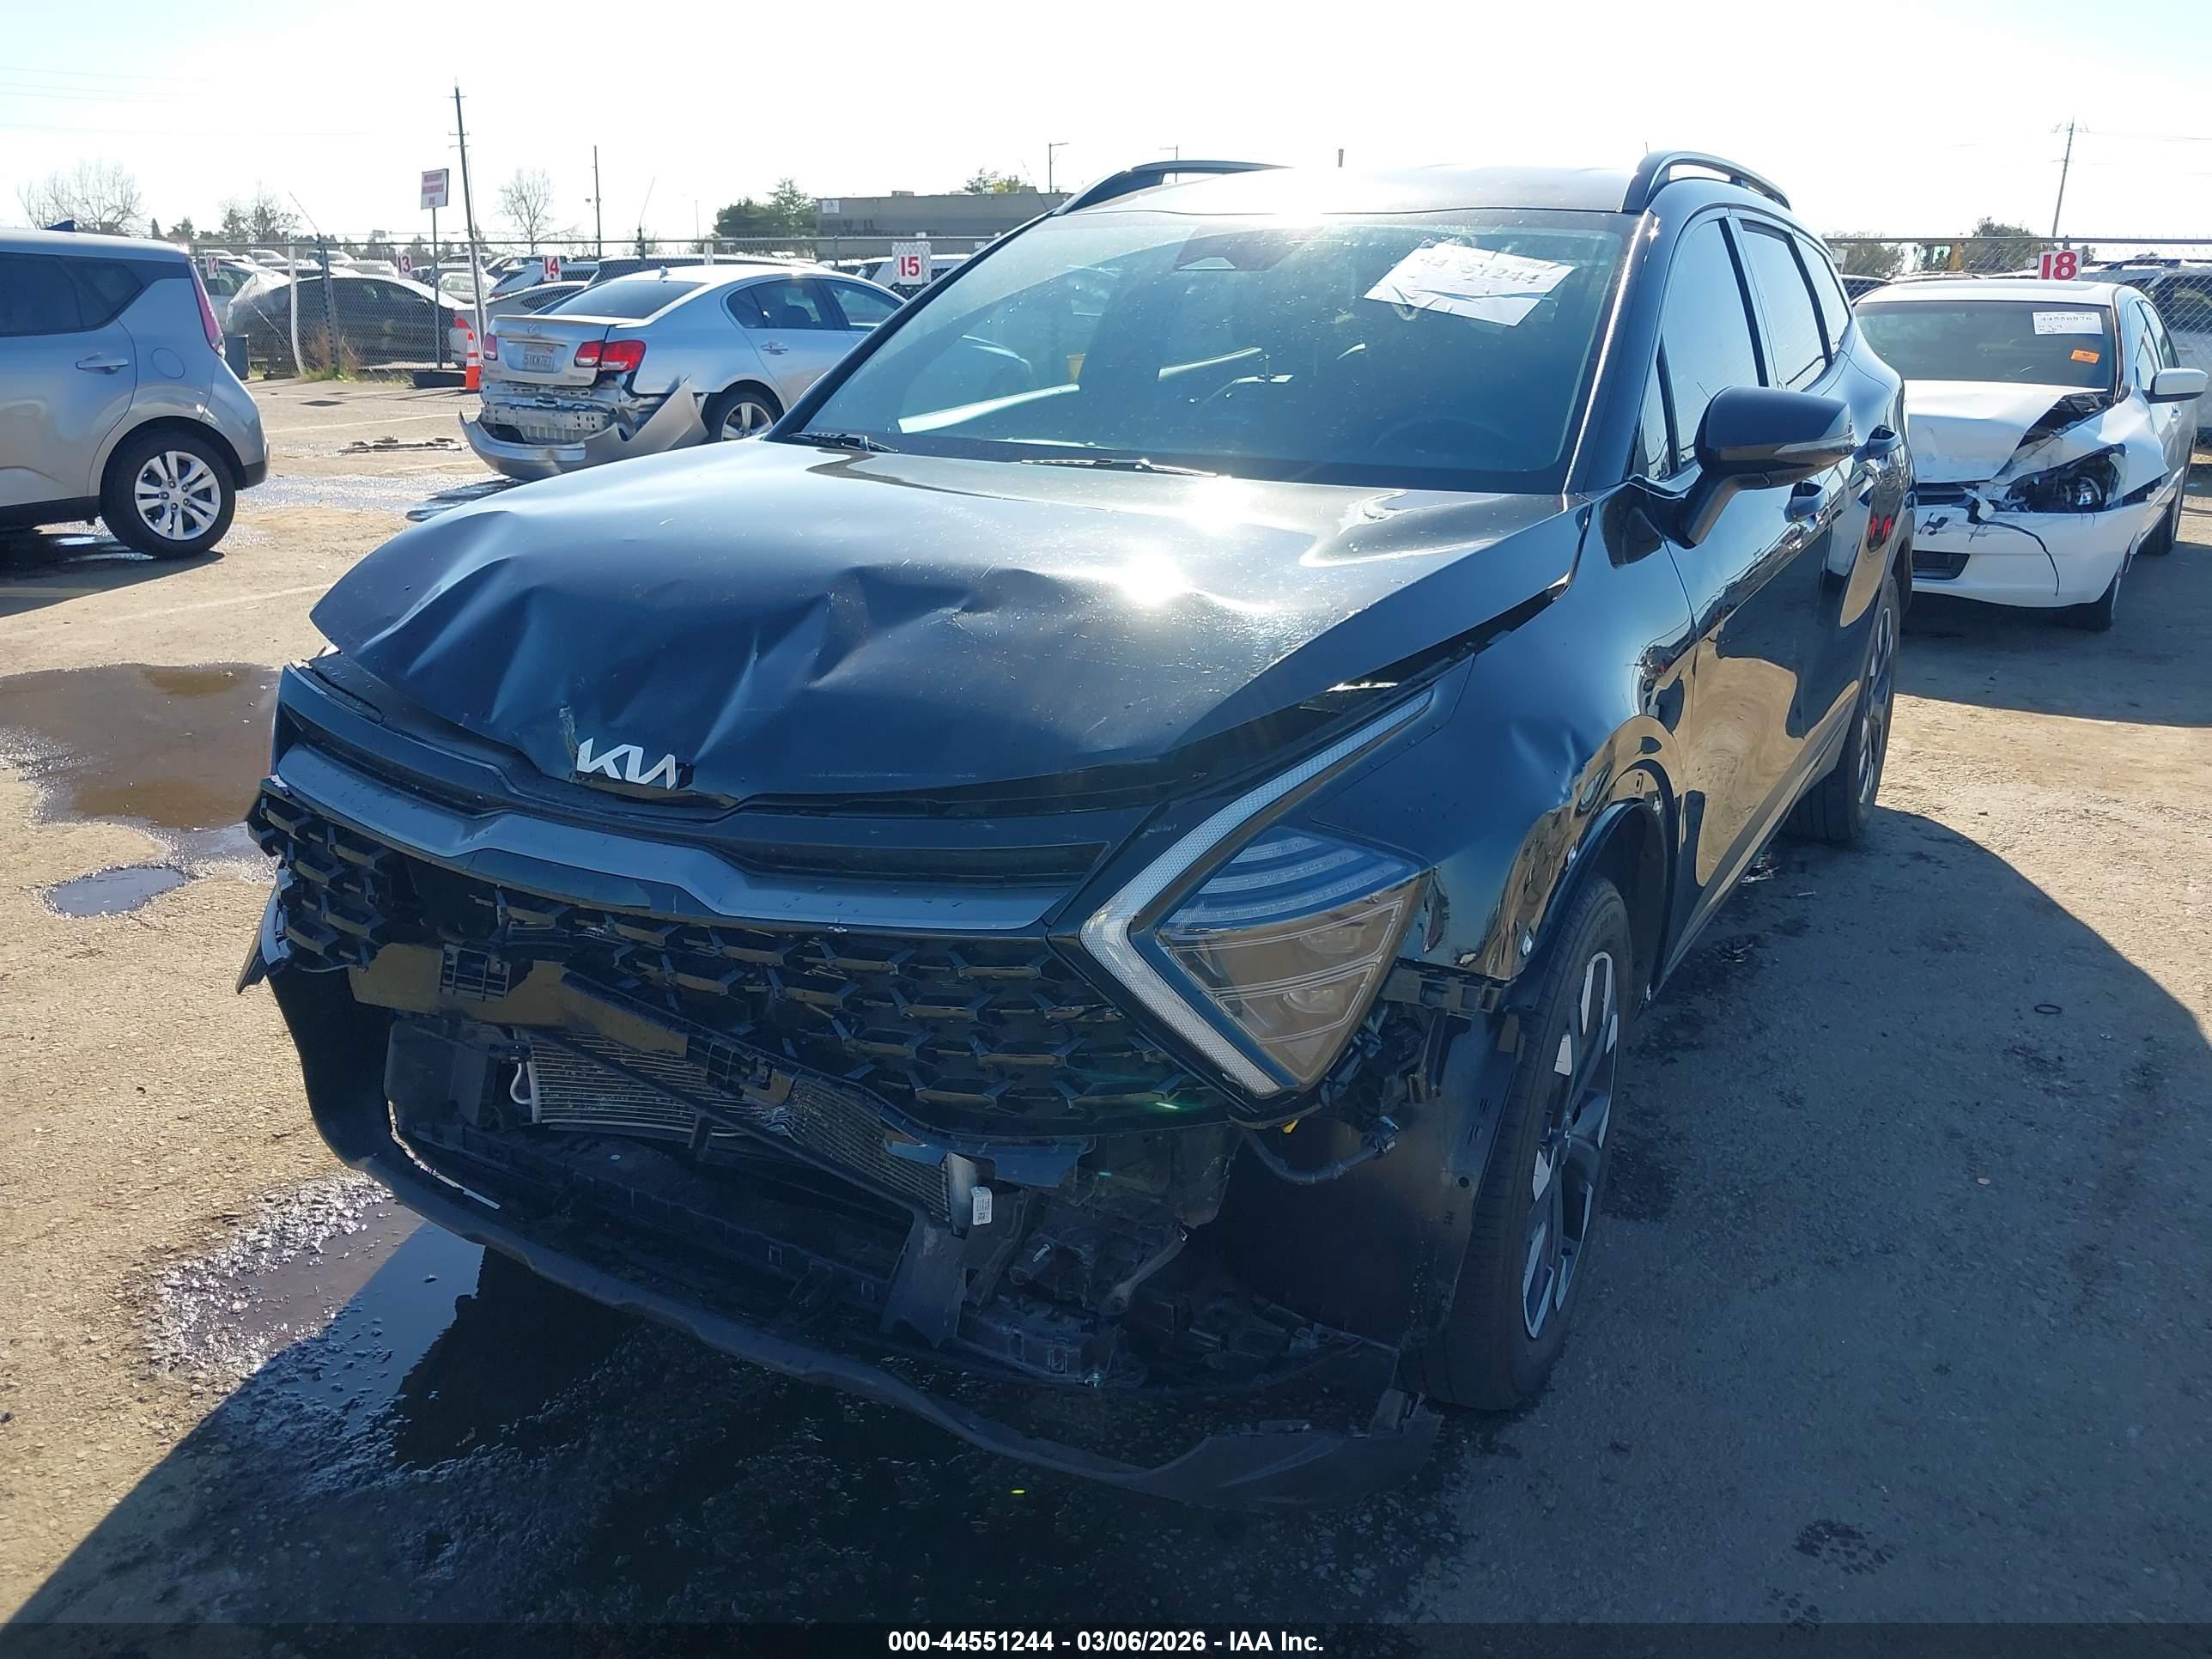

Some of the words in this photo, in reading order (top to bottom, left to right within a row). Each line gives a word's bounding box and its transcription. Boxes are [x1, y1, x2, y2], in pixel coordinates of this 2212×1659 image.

[398, 256, 410, 273] 13
[544, 257, 560, 275] 14
[901, 256, 920, 276] 15
[2041, 252, 2077, 280] 18
[577, 738, 677, 790] KIA
